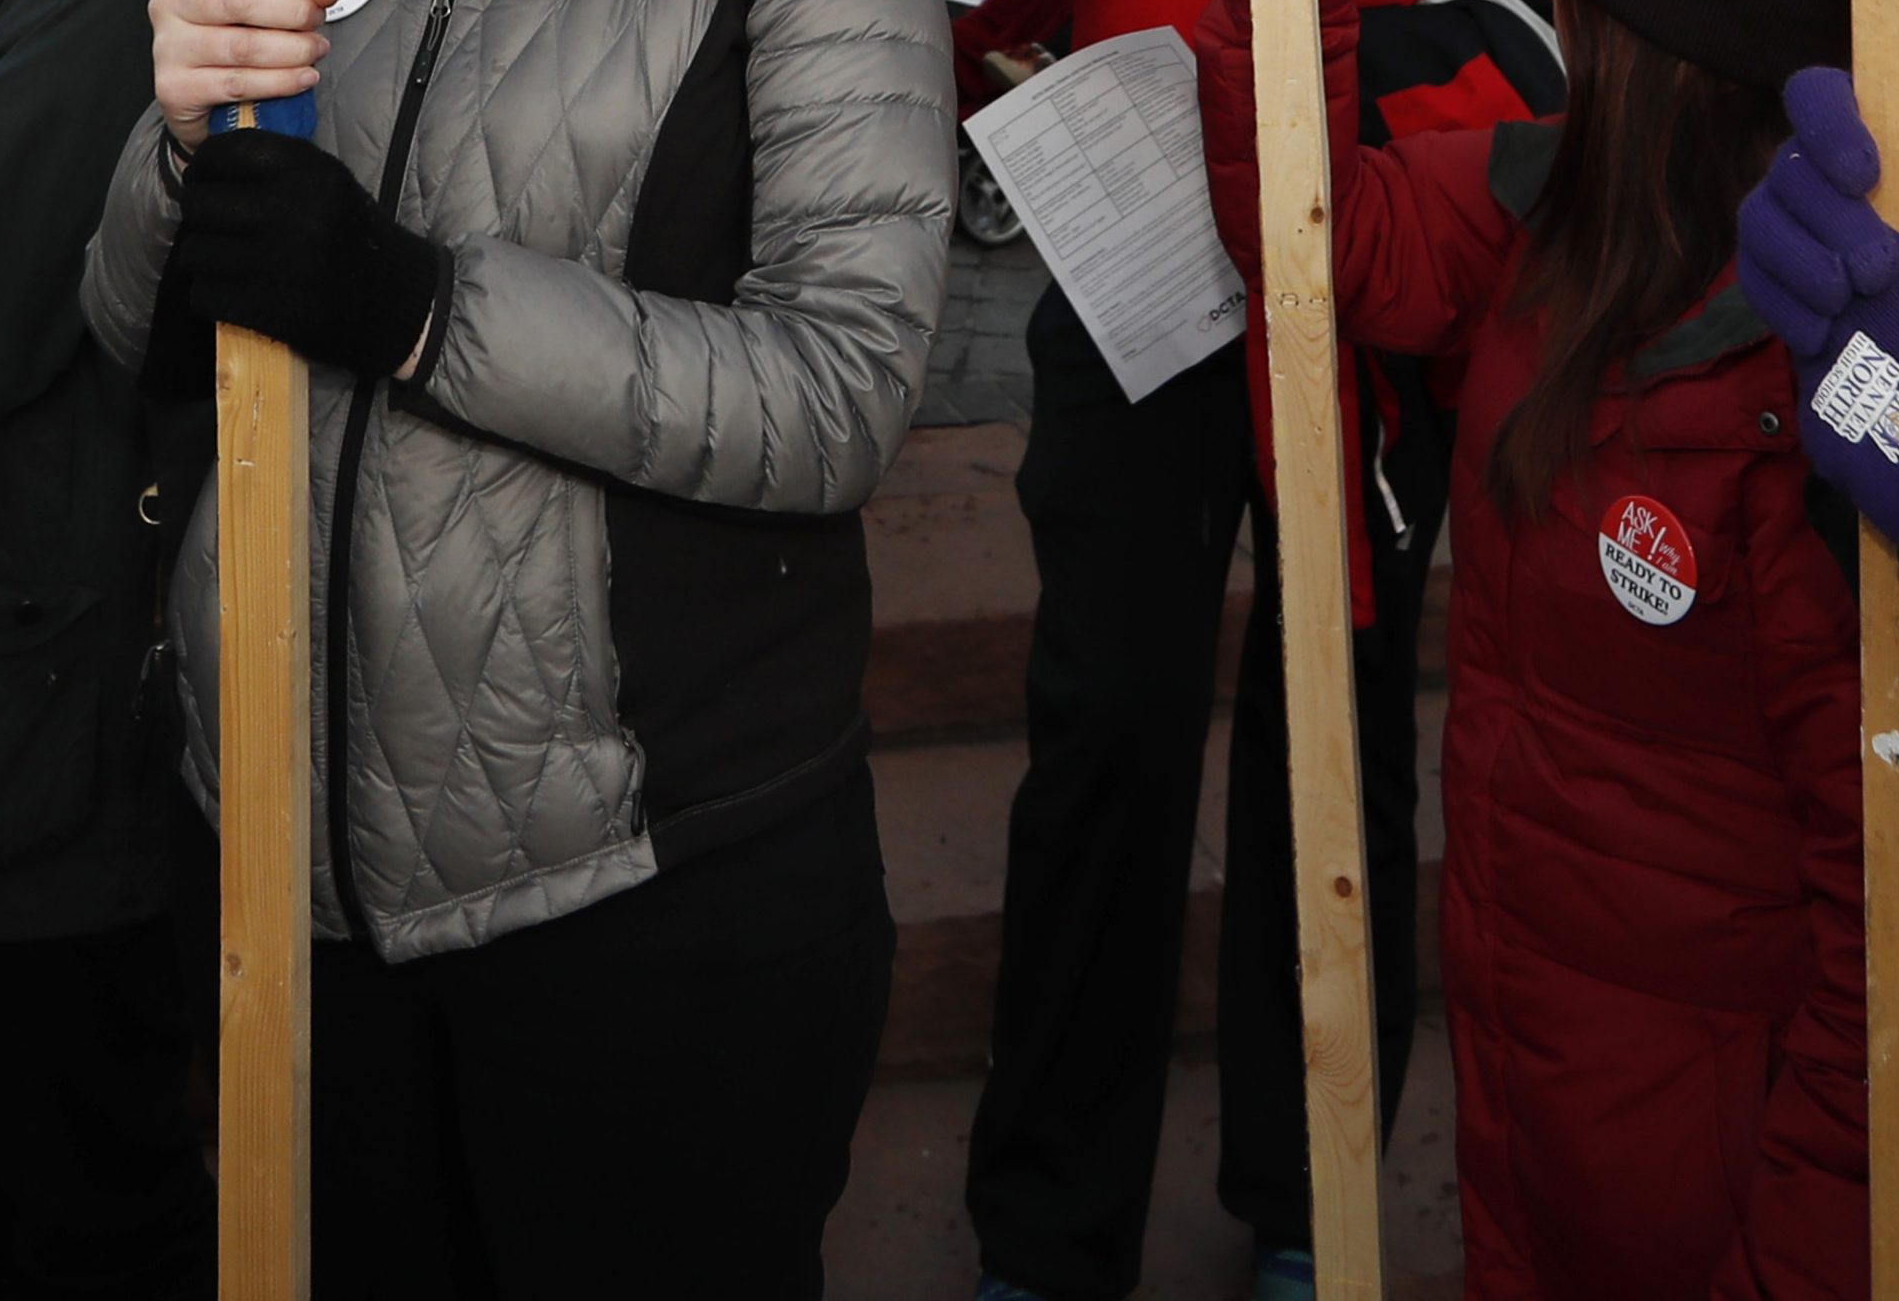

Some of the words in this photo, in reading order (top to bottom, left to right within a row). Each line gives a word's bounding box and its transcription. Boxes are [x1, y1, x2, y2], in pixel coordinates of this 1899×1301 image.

[1840, 334, 1868, 369] HIGH
[1822, 344, 1886, 428] NORTH
[1617, 520, 1642, 554] ME
[1621, 501, 1658, 539] ASK
[1605, 543, 1656, 585] READY
[1659, 577, 1682, 601] TO
[1610, 568, 1669, 616] STRIKE!
